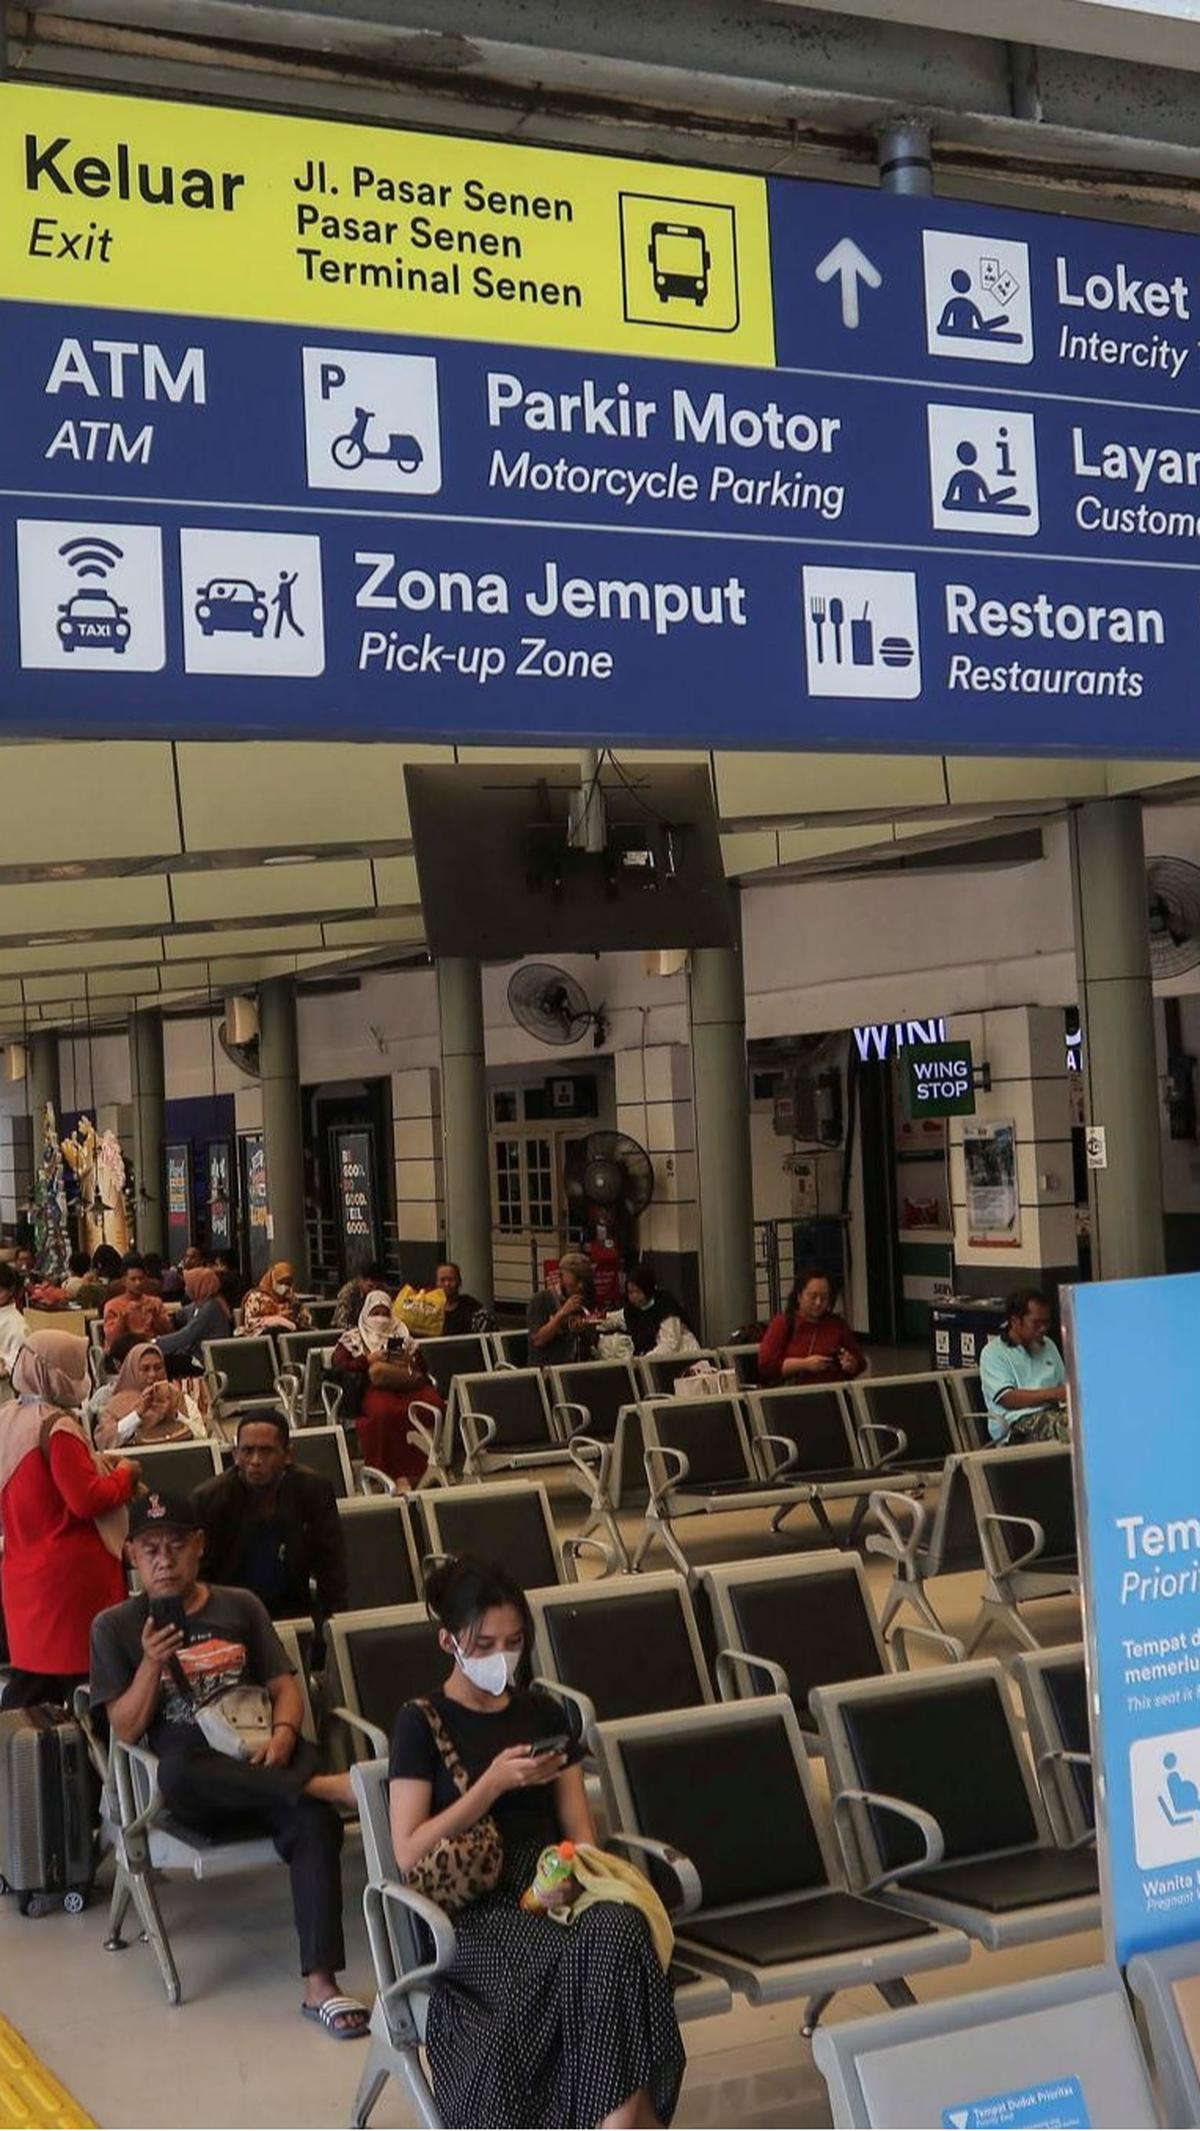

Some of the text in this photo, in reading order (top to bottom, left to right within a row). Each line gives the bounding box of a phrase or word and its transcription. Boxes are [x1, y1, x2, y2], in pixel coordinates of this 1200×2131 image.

[25, 134, 245, 210] Keluar
[294, 160, 574, 222] Jl. Pasar Senen
[28, 218, 113, 262] Exit
[298, 204, 522, 258] Pasar Senen
[297, 247, 583, 307] Terminal Senen
[1057, 257, 1190, 321] Loket
[45, 337, 207, 405] ATM
[1059, 326, 1189, 378] Intercity
[321, 363, 346, 400] P
[486, 372, 841, 454] Parkir Motor
[44, 419, 154, 464] ATM
[488, 450, 845, 521] Motorcycle Parking
[354, 552, 748, 635] Zona Jemput
[945, 584, 1165, 645] Restoran
[77, 623, 111, 637] TAXI
[359, 631, 613, 684] Pick-up Zone
[948, 656, 1144, 697] Restaurants
[853, 1018, 945, 1061] WIN
[912, 1060, 968, 1080] WING
[916, 1080, 969, 1100] STOP
[1122, 1632, 1187, 1659] Tempat
[1124, 1654, 1200, 1685] memerlu
[1127, 1695, 1152, 1713] This
[1142, 1874, 1193, 1898] Wanita
